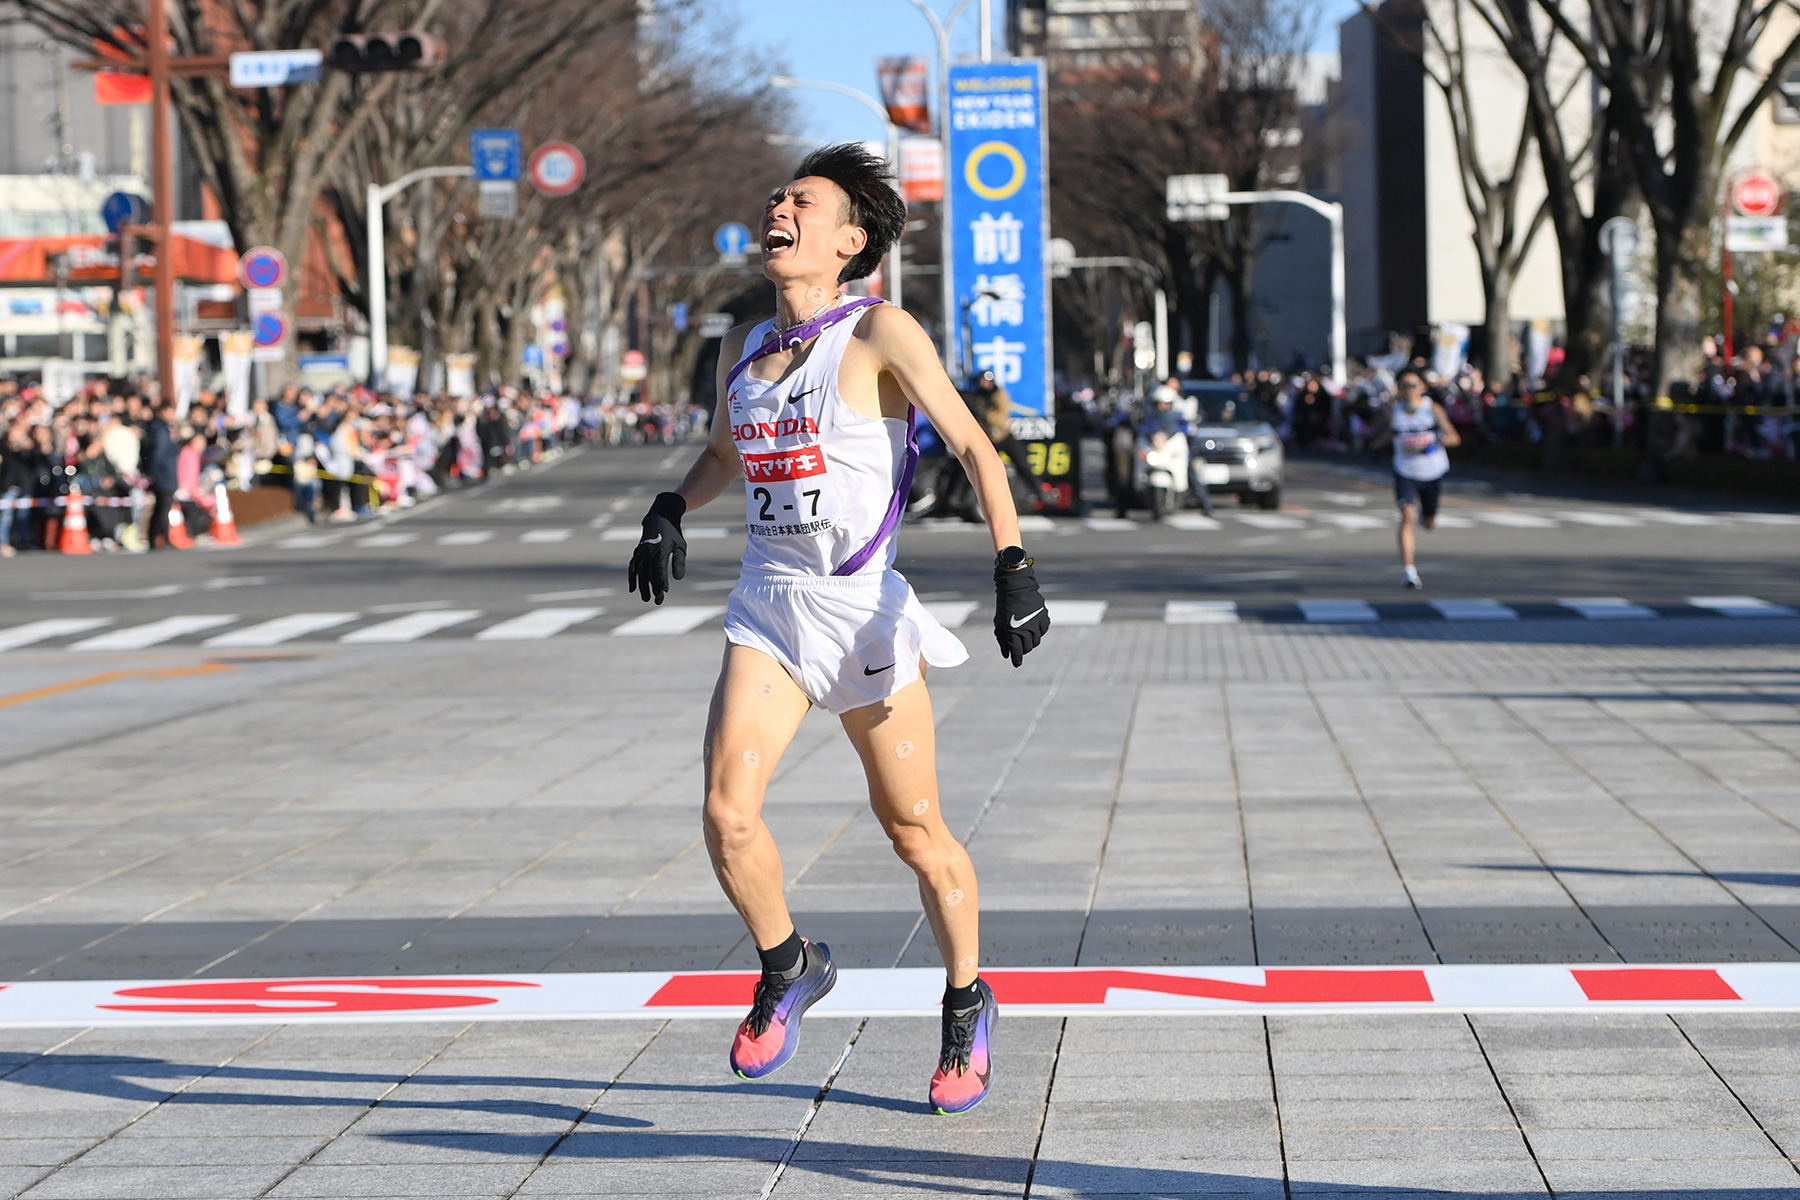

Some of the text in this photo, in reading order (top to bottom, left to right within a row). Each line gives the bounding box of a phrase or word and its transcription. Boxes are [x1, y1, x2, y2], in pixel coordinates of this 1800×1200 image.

[953, 93, 1034, 110] NEW YEAR
[953, 110, 1035, 130] EKIDEN
[969, 211, 1026, 385] 前橋市
[732, 417, 820, 441] HONDA
[747, 454, 818, 476] ヤマザキ
[749, 518, 832, 537] 第70回全日本実業団駅伝
